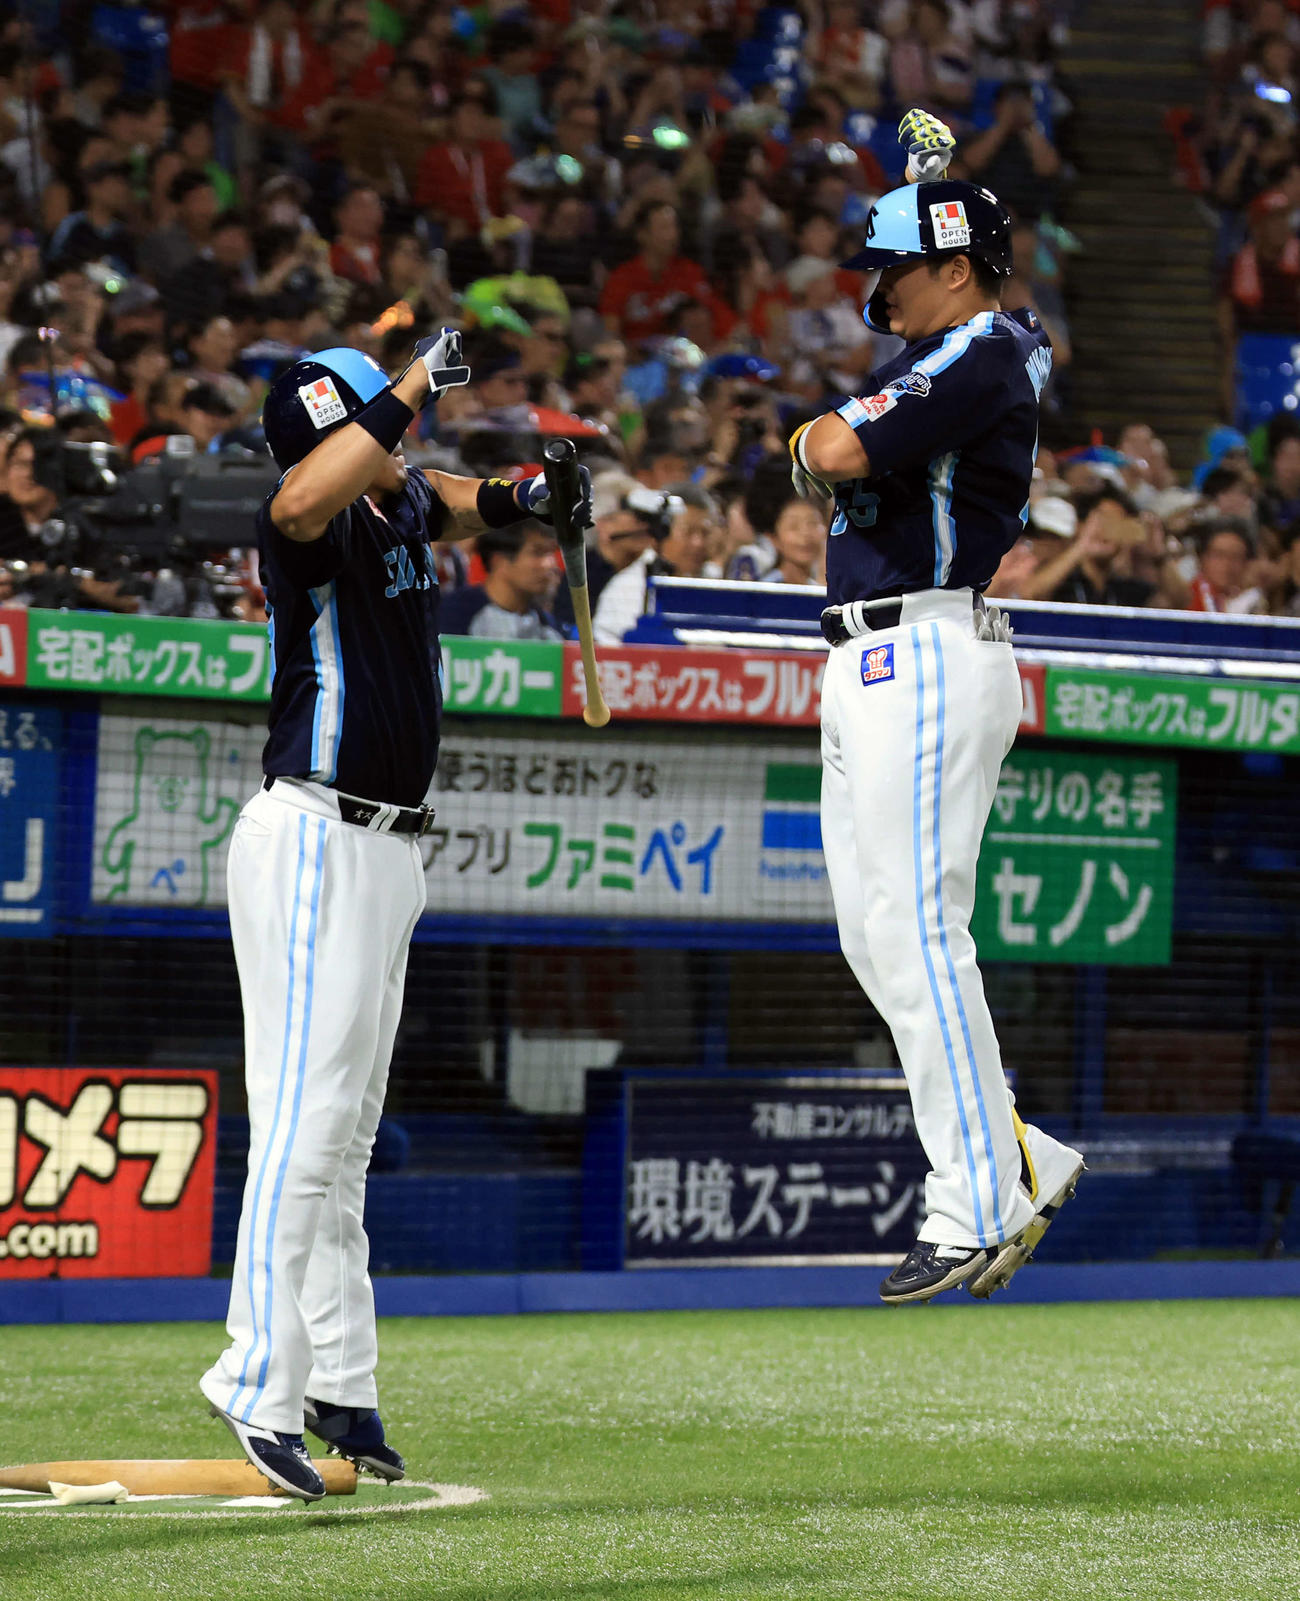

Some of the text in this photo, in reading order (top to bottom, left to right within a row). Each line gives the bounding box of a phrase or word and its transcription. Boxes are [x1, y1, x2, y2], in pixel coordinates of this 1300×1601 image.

[941, 229, 968, 239] OPEN
[942, 237, 969, 246] HOUSE
[316, 402, 342, 419] OPEN
[320, 409, 345, 425] HOUSE
[36, 625, 272, 694] 宅配ボックスはフ
[572, 658, 821, 717] 宅配ボックスはフル
[864, 668, 891, 682] タフマン
[995, 765, 1165, 829] 守りの名手
[522, 818, 725, 895] ファミペイ
[991, 856, 1153, 947] セノン
[627, 1157, 927, 1245] 環境ステーシ
